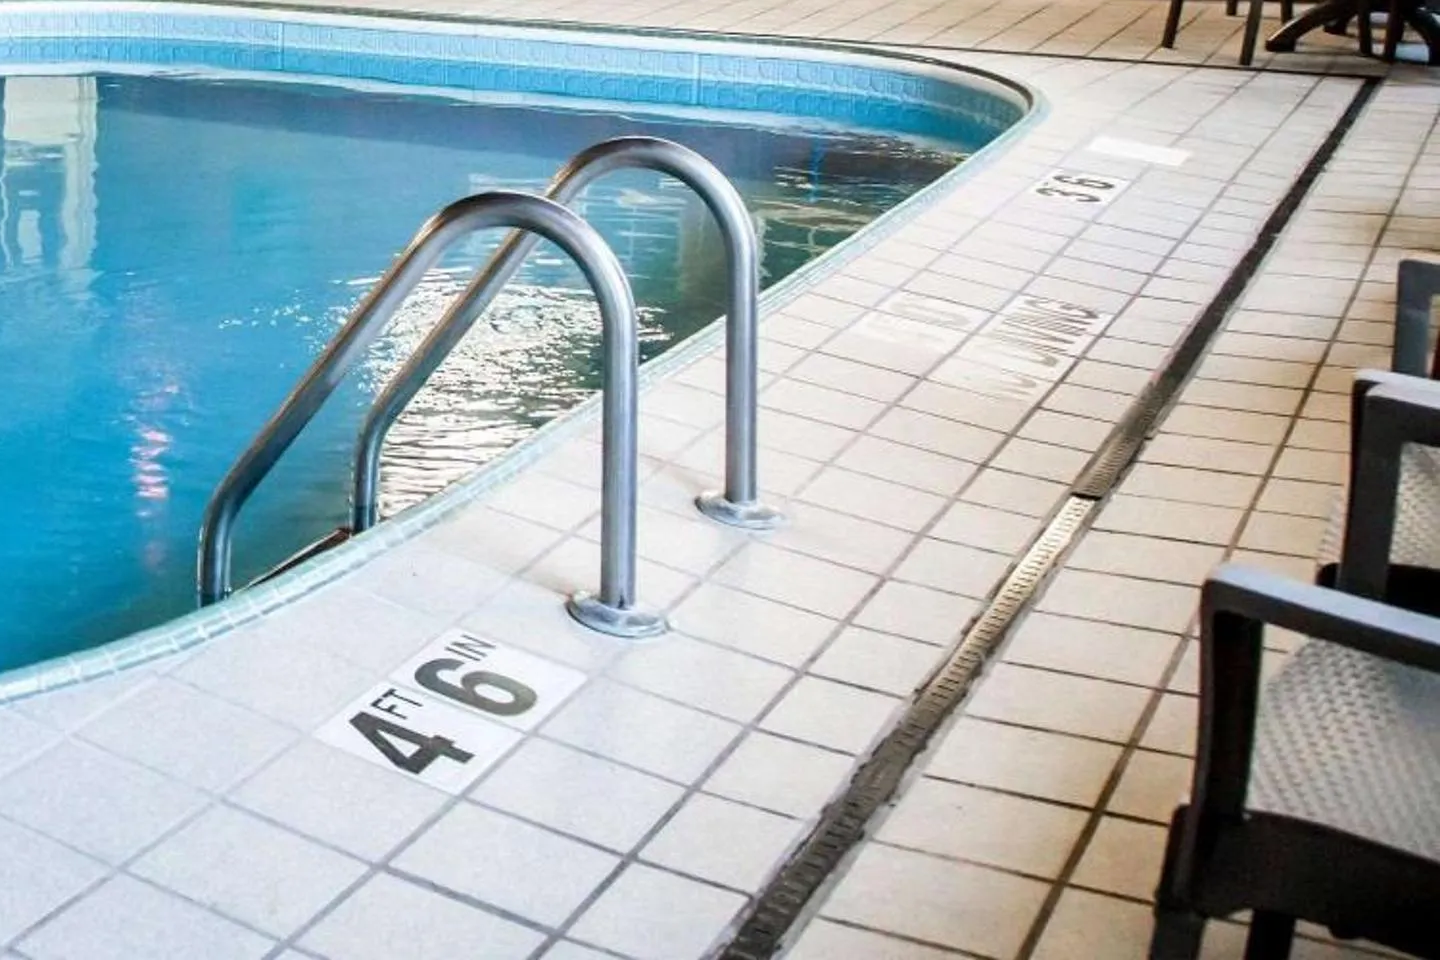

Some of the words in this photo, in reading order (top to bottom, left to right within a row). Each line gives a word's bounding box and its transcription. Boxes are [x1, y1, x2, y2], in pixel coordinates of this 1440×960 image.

[444, 634, 496, 661] IN
[370, 688, 424, 720] FT
[414, 657, 538, 717] 6
[348, 711, 476, 775] 4
